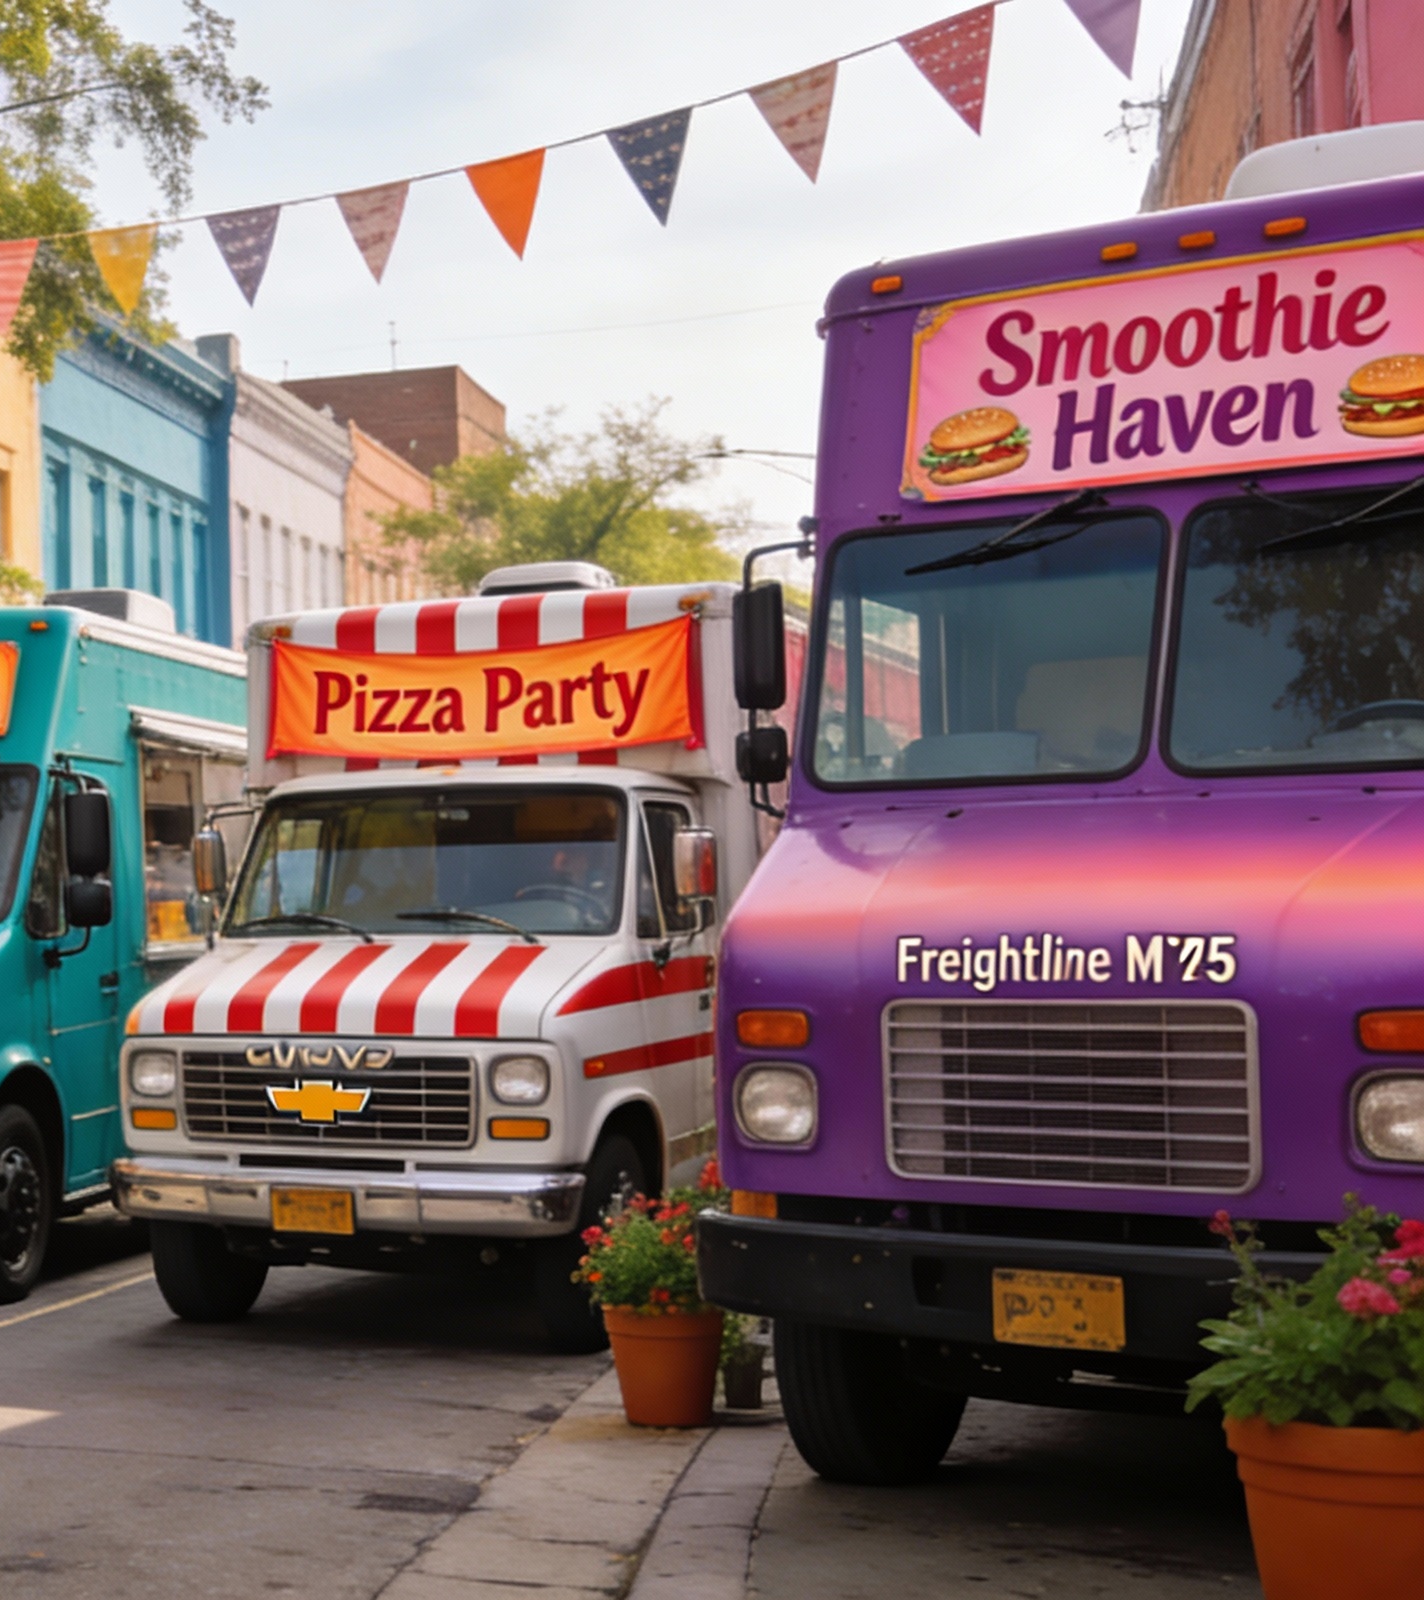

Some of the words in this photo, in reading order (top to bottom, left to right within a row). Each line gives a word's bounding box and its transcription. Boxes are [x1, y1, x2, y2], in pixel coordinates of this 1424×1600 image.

[978, 269, 1391, 397] Smoothie
[1052, 378, 1320, 471] Haven
[313, 670, 465, 735] Pizza
[482, 660, 651, 738] Party
[897, 932, 1112, 992] Freightline
